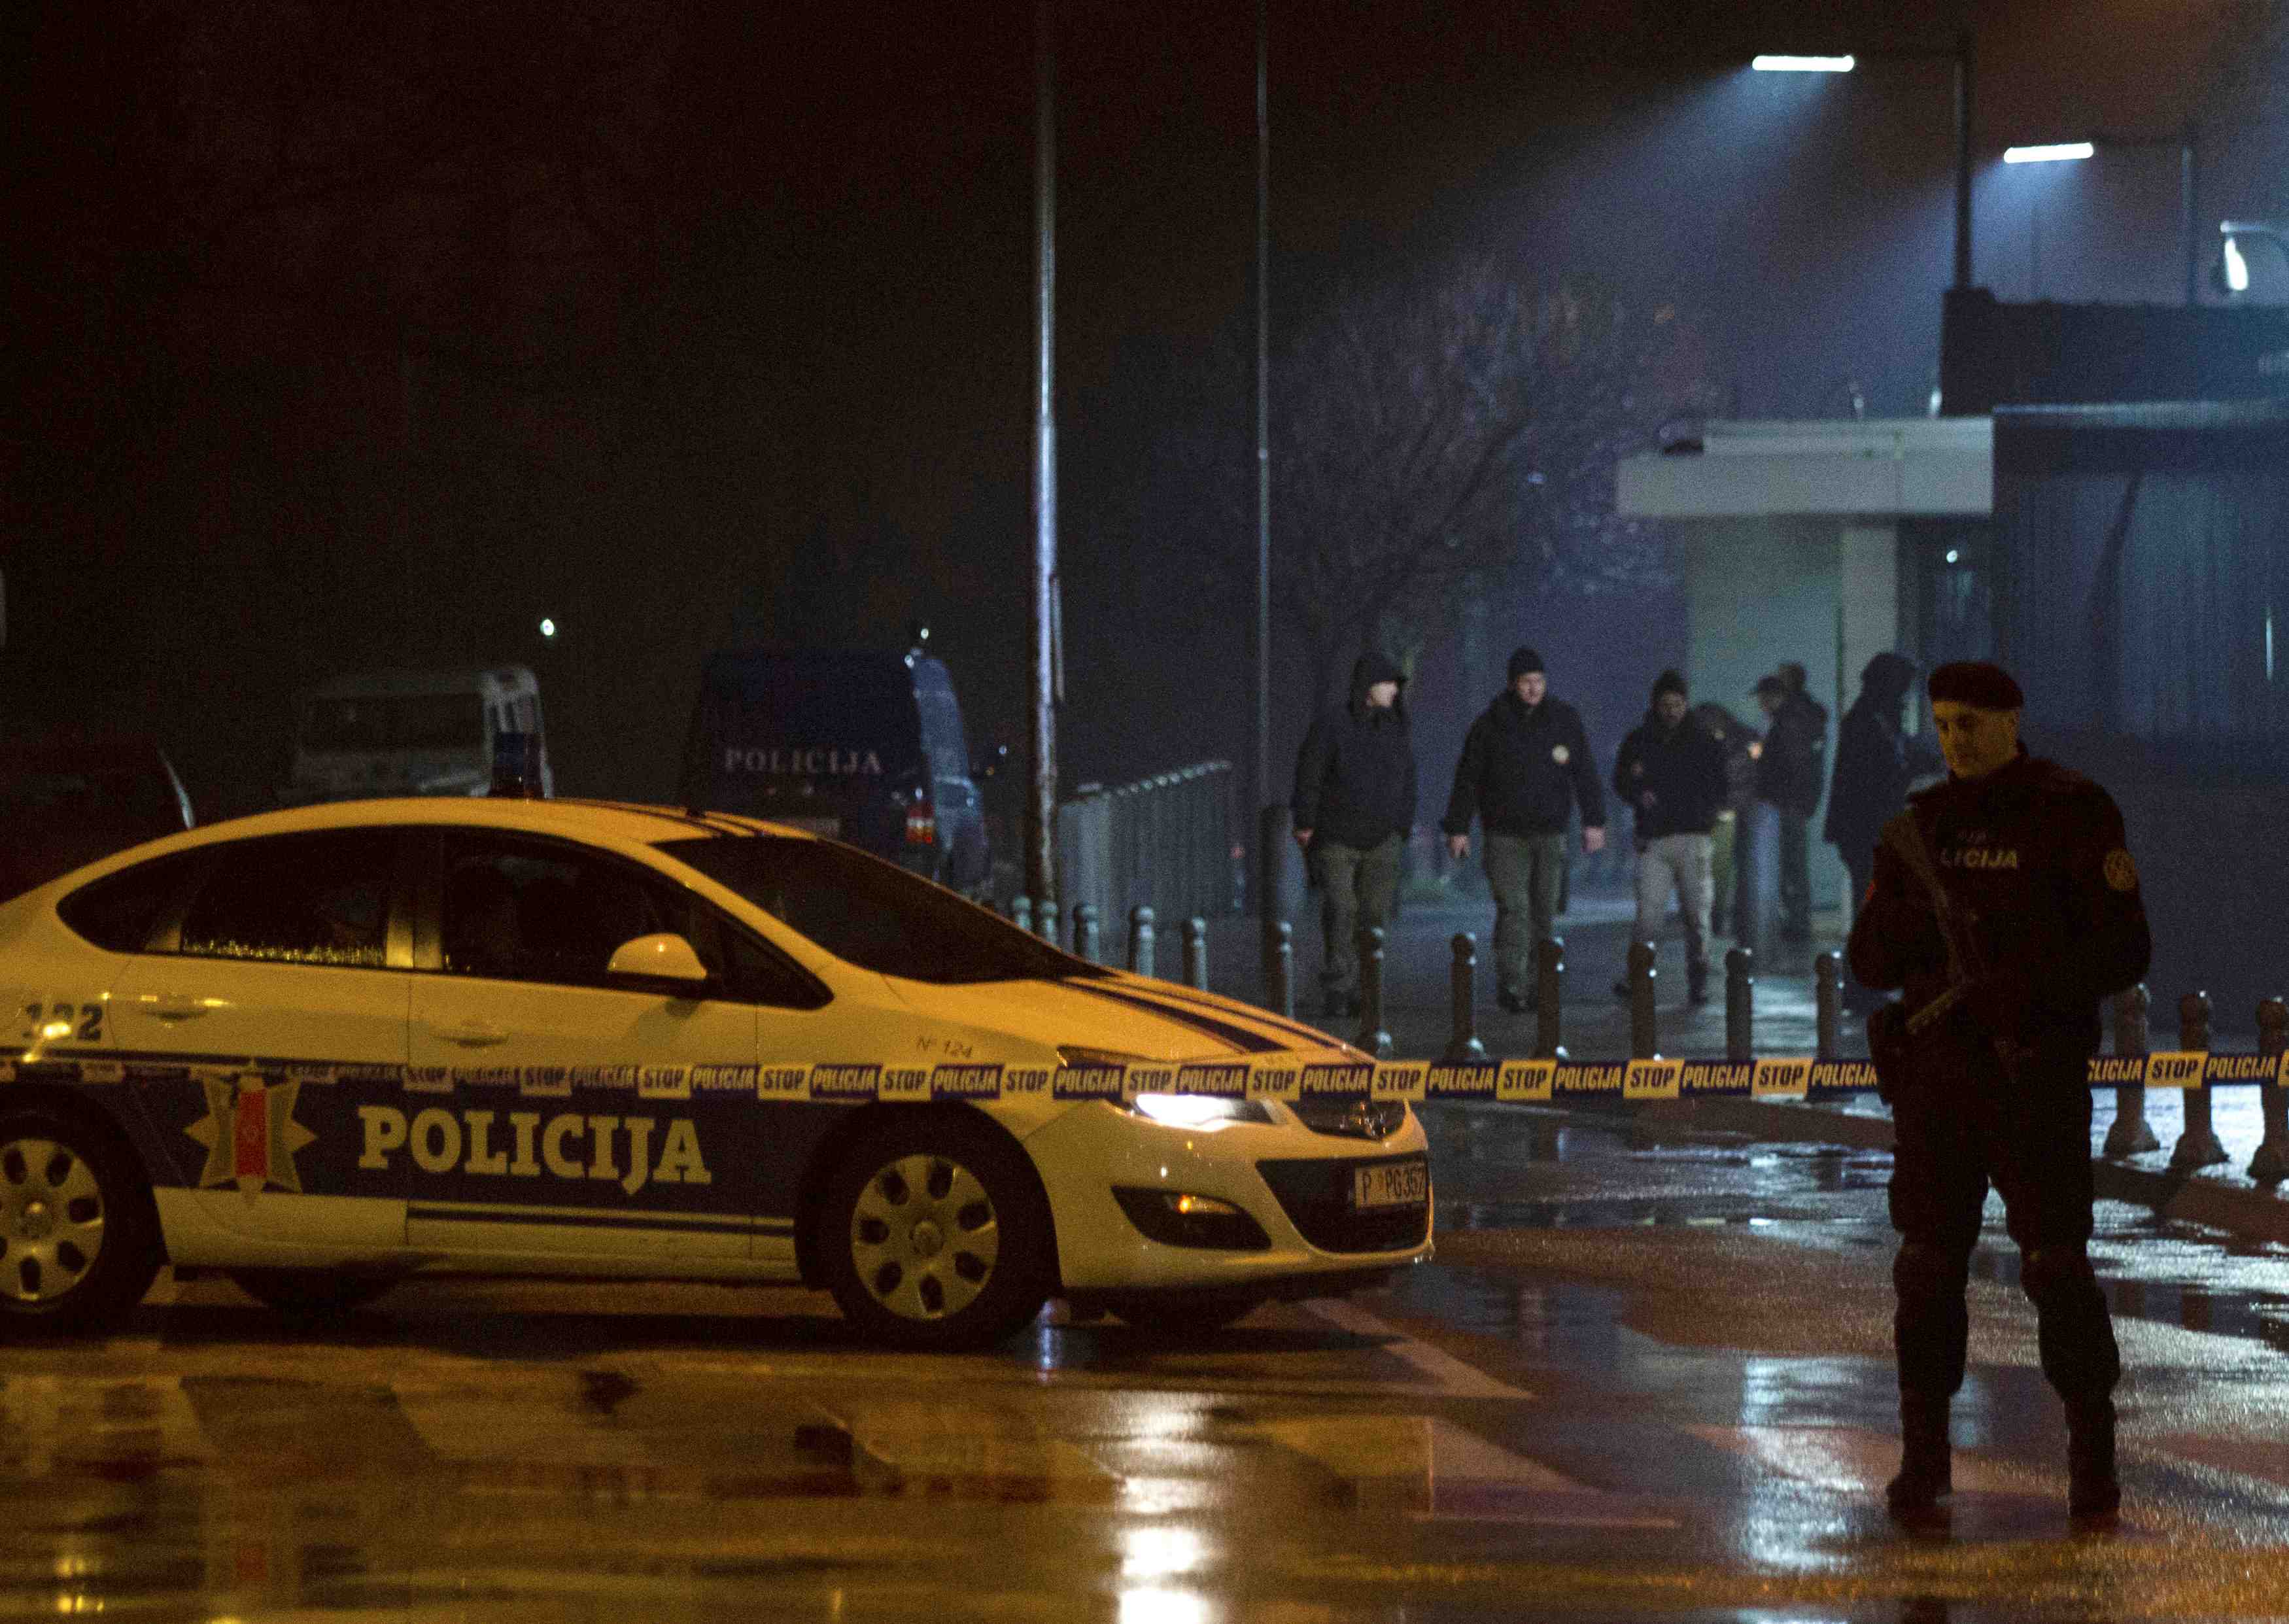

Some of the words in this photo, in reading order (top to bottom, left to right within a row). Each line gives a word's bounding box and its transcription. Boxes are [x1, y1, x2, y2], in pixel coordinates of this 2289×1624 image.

[724, 748, 883, 774] POLICIJA
[644, 1067, 683, 1087] STOP
[693, 1067, 755, 1089] POLICIJA
[763, 1069, 805, 1089] STOP
[812, 1067, 877, 1092] POLICIJA
[884, 1069, 925, 1091] STOP
[933, 1067, 1000, 1093] POLICIJA
[1006, 1070, 1048, 1092] STOP
[1056, 1067, 1118, 1093] POLICIJA
[1129, 1070, 1172, 1091] STOP
[1179, 1067, 1244, 1093] POLICIJA
[1252, 1069, 1296, 1092] STOP
[1304, 1067, 1370, 1093] POLICIJA
[1377, 1068, 1420, 1091] STOP
[1429, 1066, 1495, 1092] POLICIJA
[1504, 1067, 1547, 1090] STOP
[1554, 1066, 1623, 1090] POLICIJA
[1630, 1065, 1676, 1088] STOP
[1683, 1064, 1751, 1088] POLICIJA
[1758, 1064, 1804, 1087] STOP
[1811, 1062, 1880, 1087] POLICIJA
[2088, 1057, 2144, 1082] LICIJA
[2152, 1058, 2199, 1079] STOP
[2206, 1056, 2277, 1079] POLICIJA
[357, 1104, 712, 1196] POLICIJA
